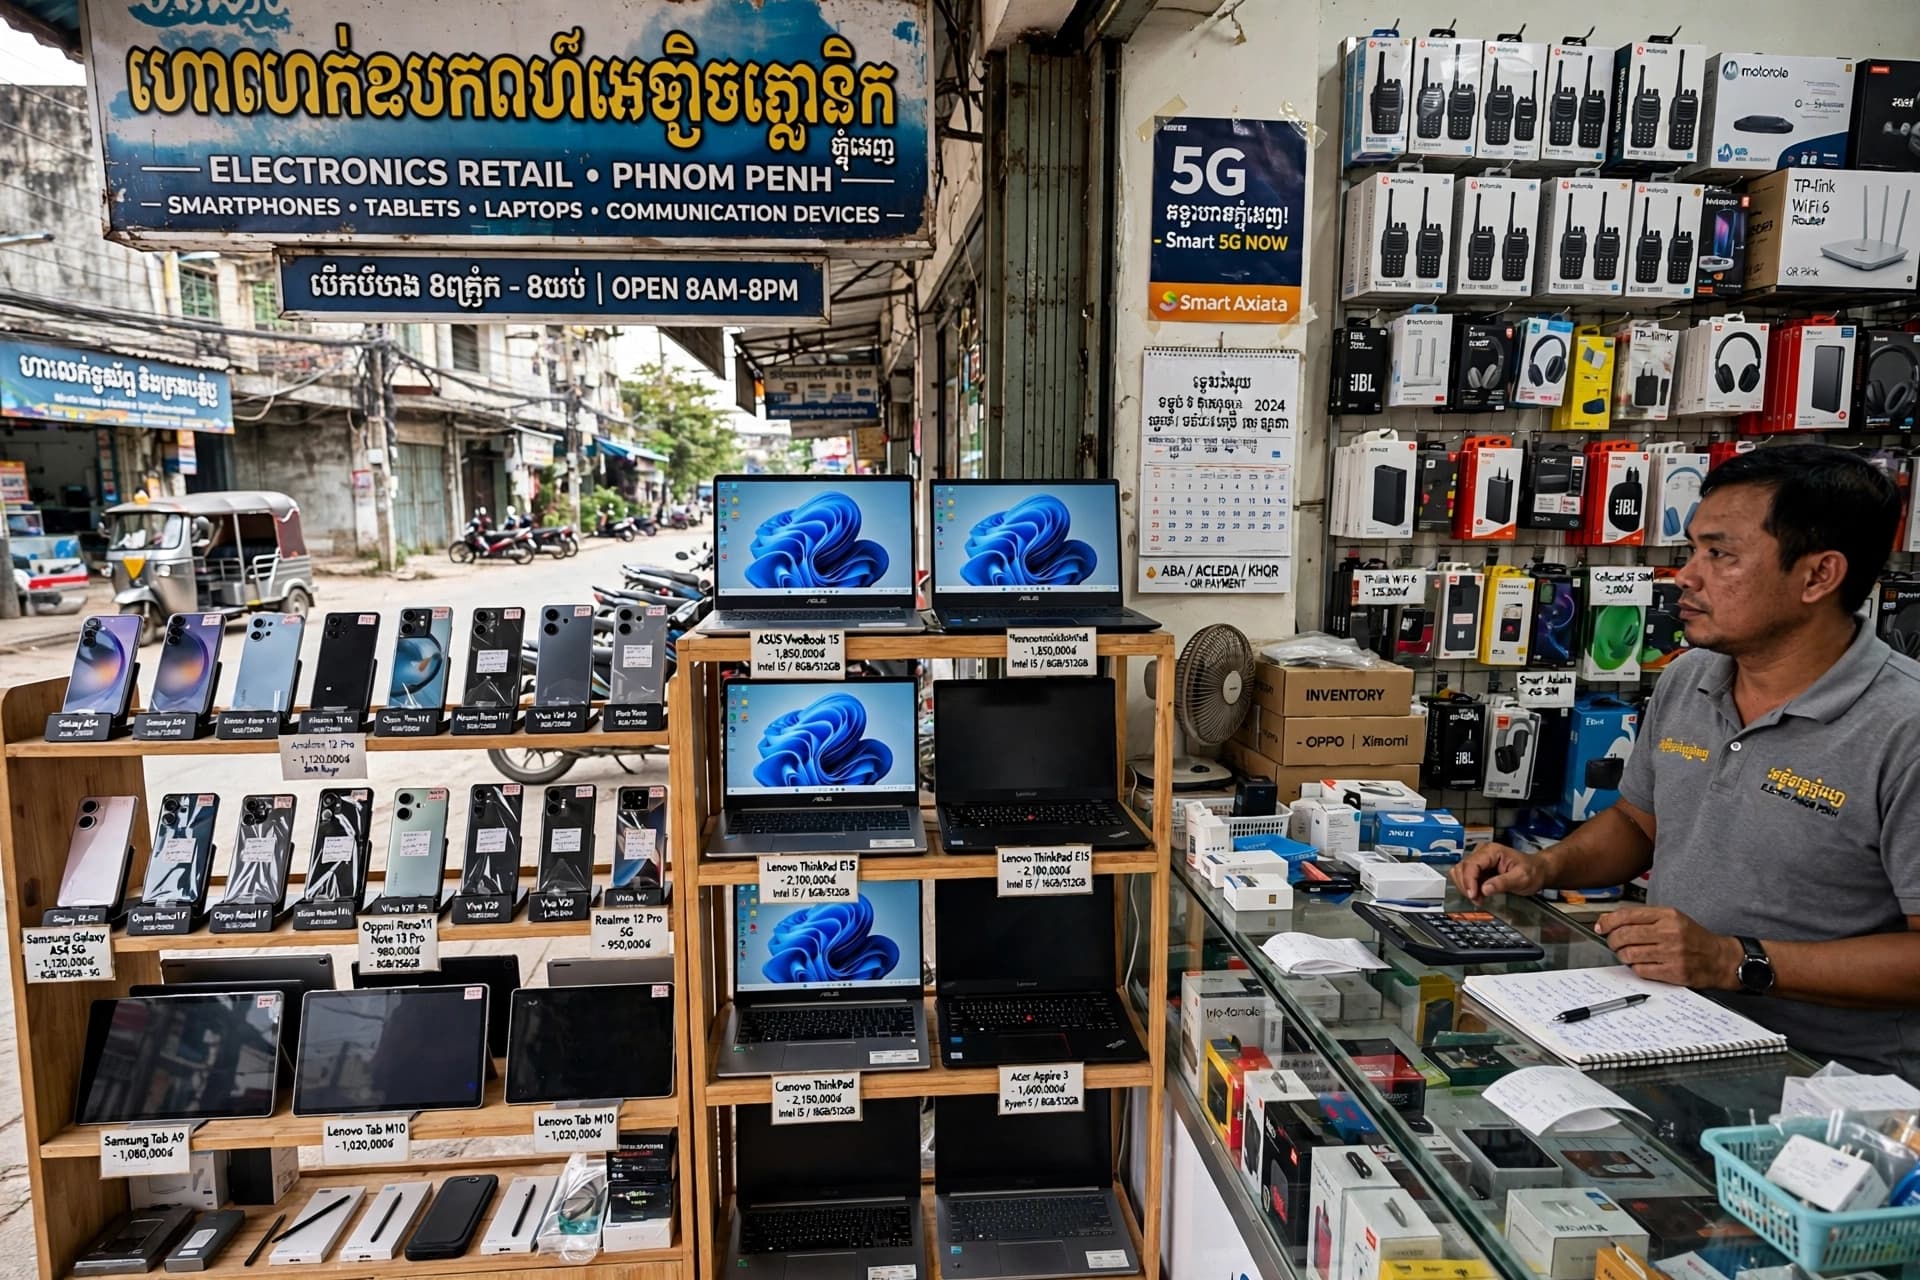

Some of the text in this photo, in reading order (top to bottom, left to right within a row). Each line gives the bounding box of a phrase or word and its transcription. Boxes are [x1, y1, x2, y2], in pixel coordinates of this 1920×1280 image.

[1742, 66, 1788, 79] motorola
[209, 155, 832, 193] ELECTRONICS RETAIL PHNOM PENH
[1170, 146, 1245, 197] 5G
[1794, 178, 1835, 193] TP-link
[168, 196, 879, 225] SMARTPHONES TABLETS LAPTOPS COMMUNICATION DEVICES
[1792, 199, 1830, 214] WiFi 6
[1166, 232, 1215, 249] Smart
[1219, 234, 1241, 250] 5G
[1245, 235, 1288, 251] NOW
[612, 277, 678, 299] OPEN
[686, 278, 798, 301] 8AM-8PM
[1180, 295, 1288, 312] Smart Axiata
[1350, 373, 1376, 392] JBL
[1255, 399, 1285, 411] 2024
[1615, 499, 1638, 515] JBL
[1161, 565, 1185, 577] ABA
[1195, 565, 1239, 577] ACLEDA
[1248, 565, 1279, 578] KHQR
[1205, 579, 1246, 589] PAYMENT
[757, 634, 782, 645] ASUS
[829, 634, 840, 644] 15
[757, 662, 775, 671] Intel
[1012, 659, 1028, 668] Intel
[1306, 689, 1385, 702] INVENTORY
[1306, 736, 1344, 747] OPPO
[1002, 851, 1090, 863] Lenovo ThinkPad E15
[767, 860, 856, 872] Lenovo ThinkPad E15
[1006, 880, 1023, 888] Intel
[773, 889, 789, 898] Intel
[596, 914, 663, 925] Realme 12 Pro
[27, 931, 105, 945] Samsung Galaxy
[371, 933, 425, 944] Note 13 Pro
[620, 927, 634, 937] 5G
[72, 945, 86, 954] 5G
[1063, 1070, 1069, 1080] 3
[813, 1078, 854, 1091] ThinkPad
[779, 1108, 795, 1117] Intel
[538, 1113, 615, 1126] Lenovo Tab M10
[328, 1123, 406, 1137] Lenovo Tab M10
[104, 1132, 185, 1147] Samsung Tab A9
